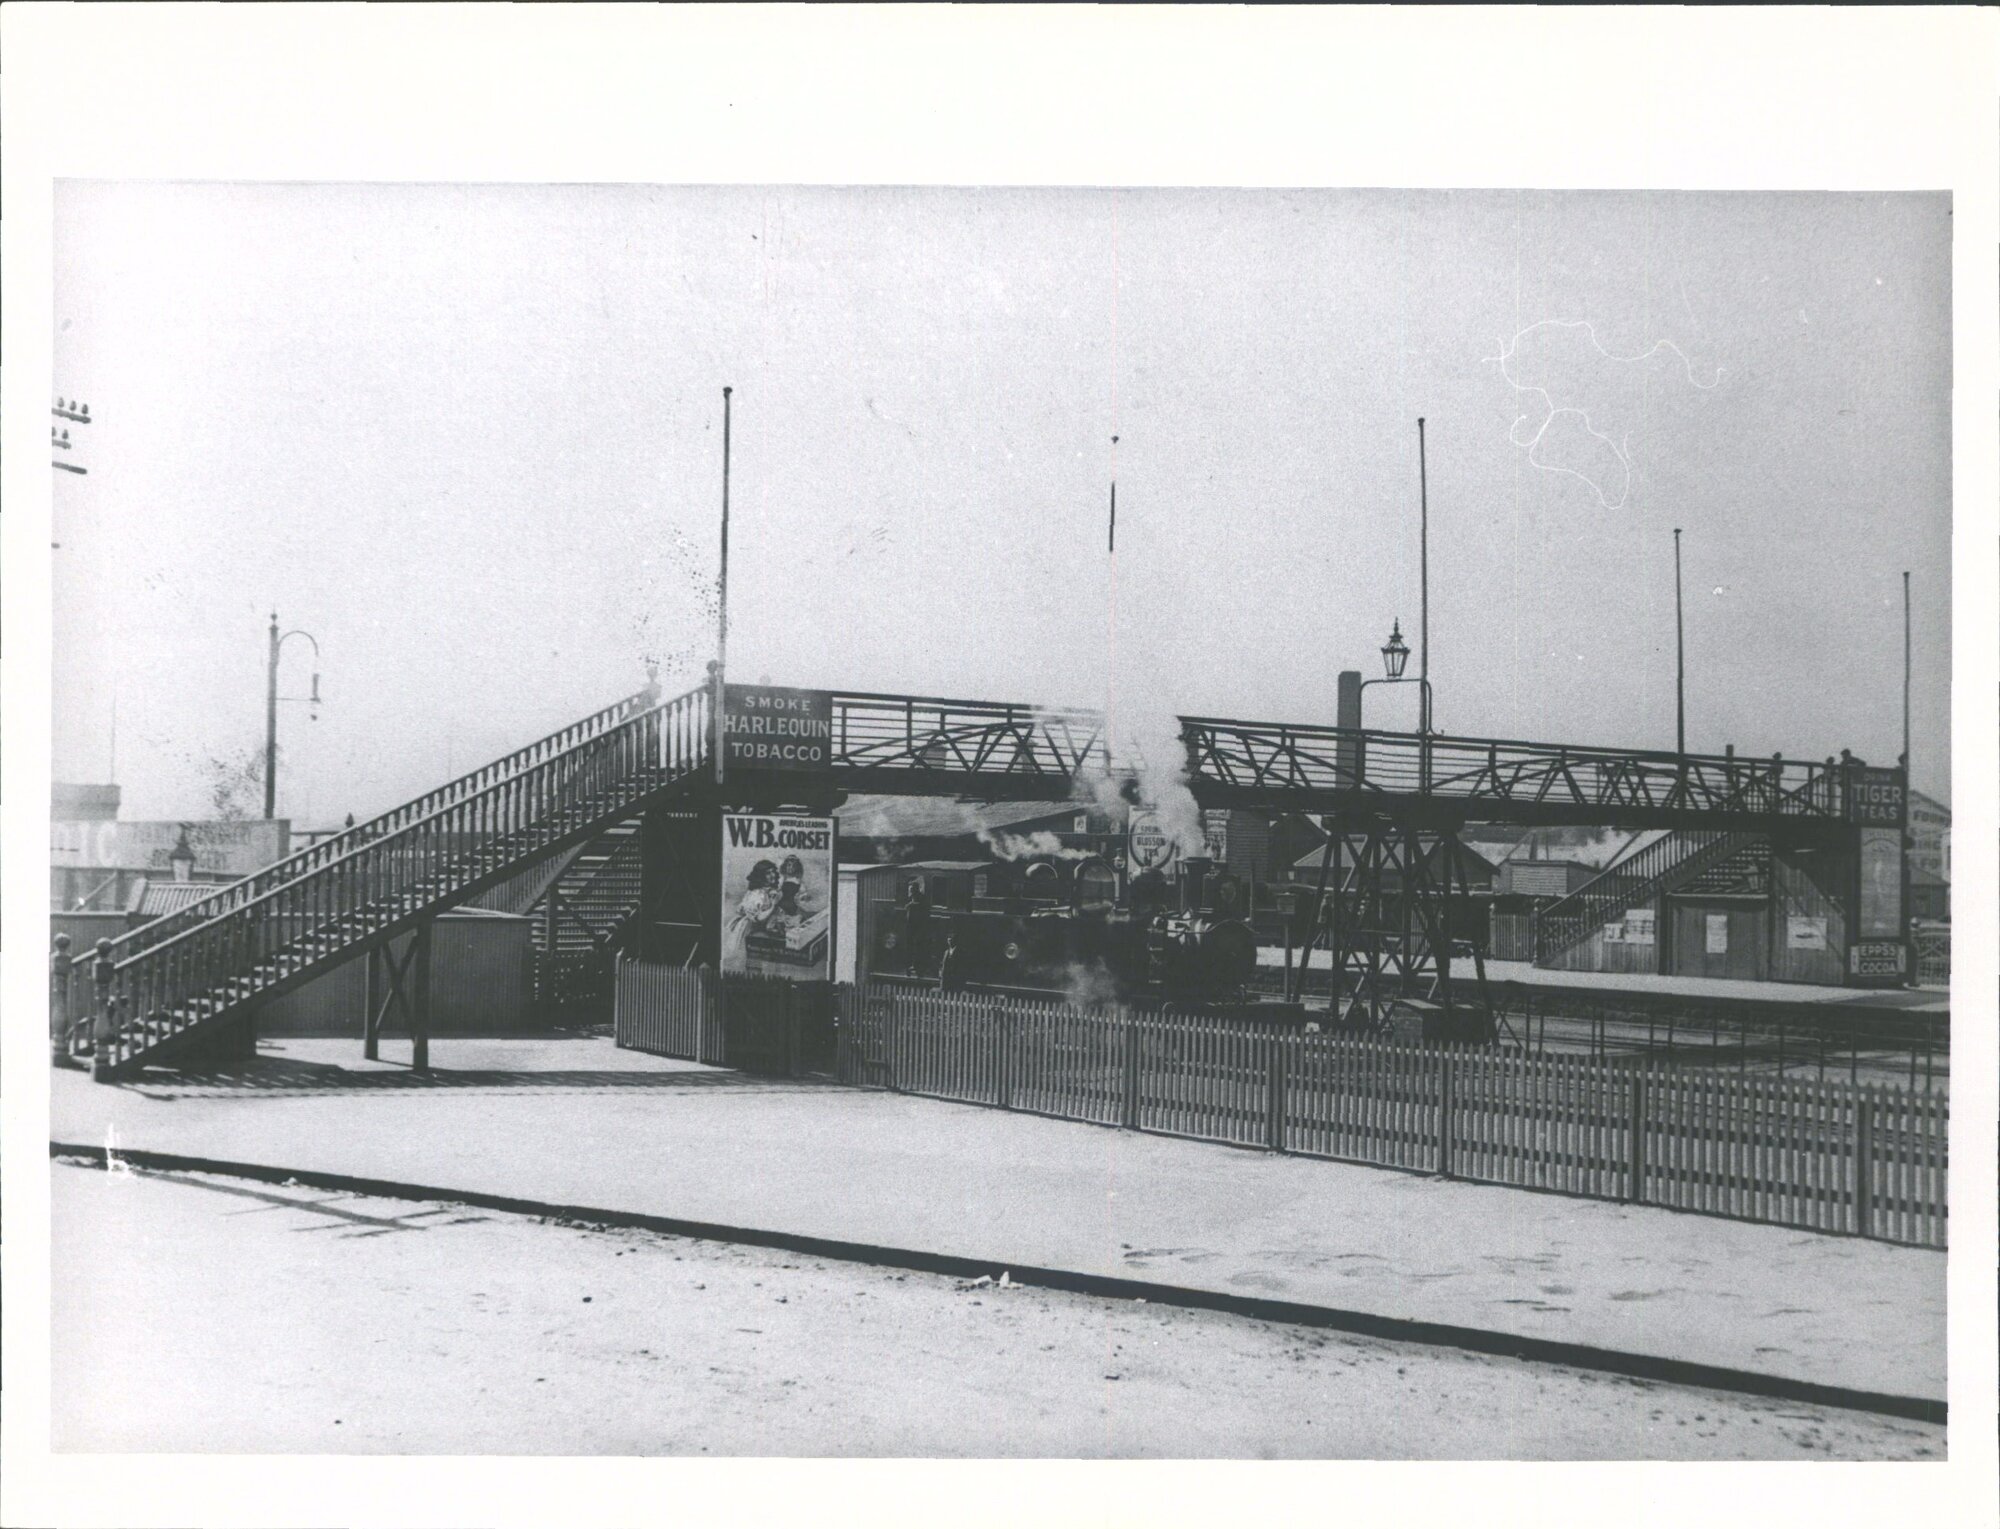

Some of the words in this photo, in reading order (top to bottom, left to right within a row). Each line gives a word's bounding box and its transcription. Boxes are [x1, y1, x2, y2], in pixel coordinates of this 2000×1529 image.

[745, 695, 811, 713] SMOKE
[723, 713, 830, 739] HARLEQUIN
[731, 742, 822, 761] TOBACCO
[1852, 784, 1903, 804] TIGER
[1860, 805, 1898, 820] TEAS
[778, 829, 831, 850] CORSET
[1860, 961, 1897, 974] COCOA
